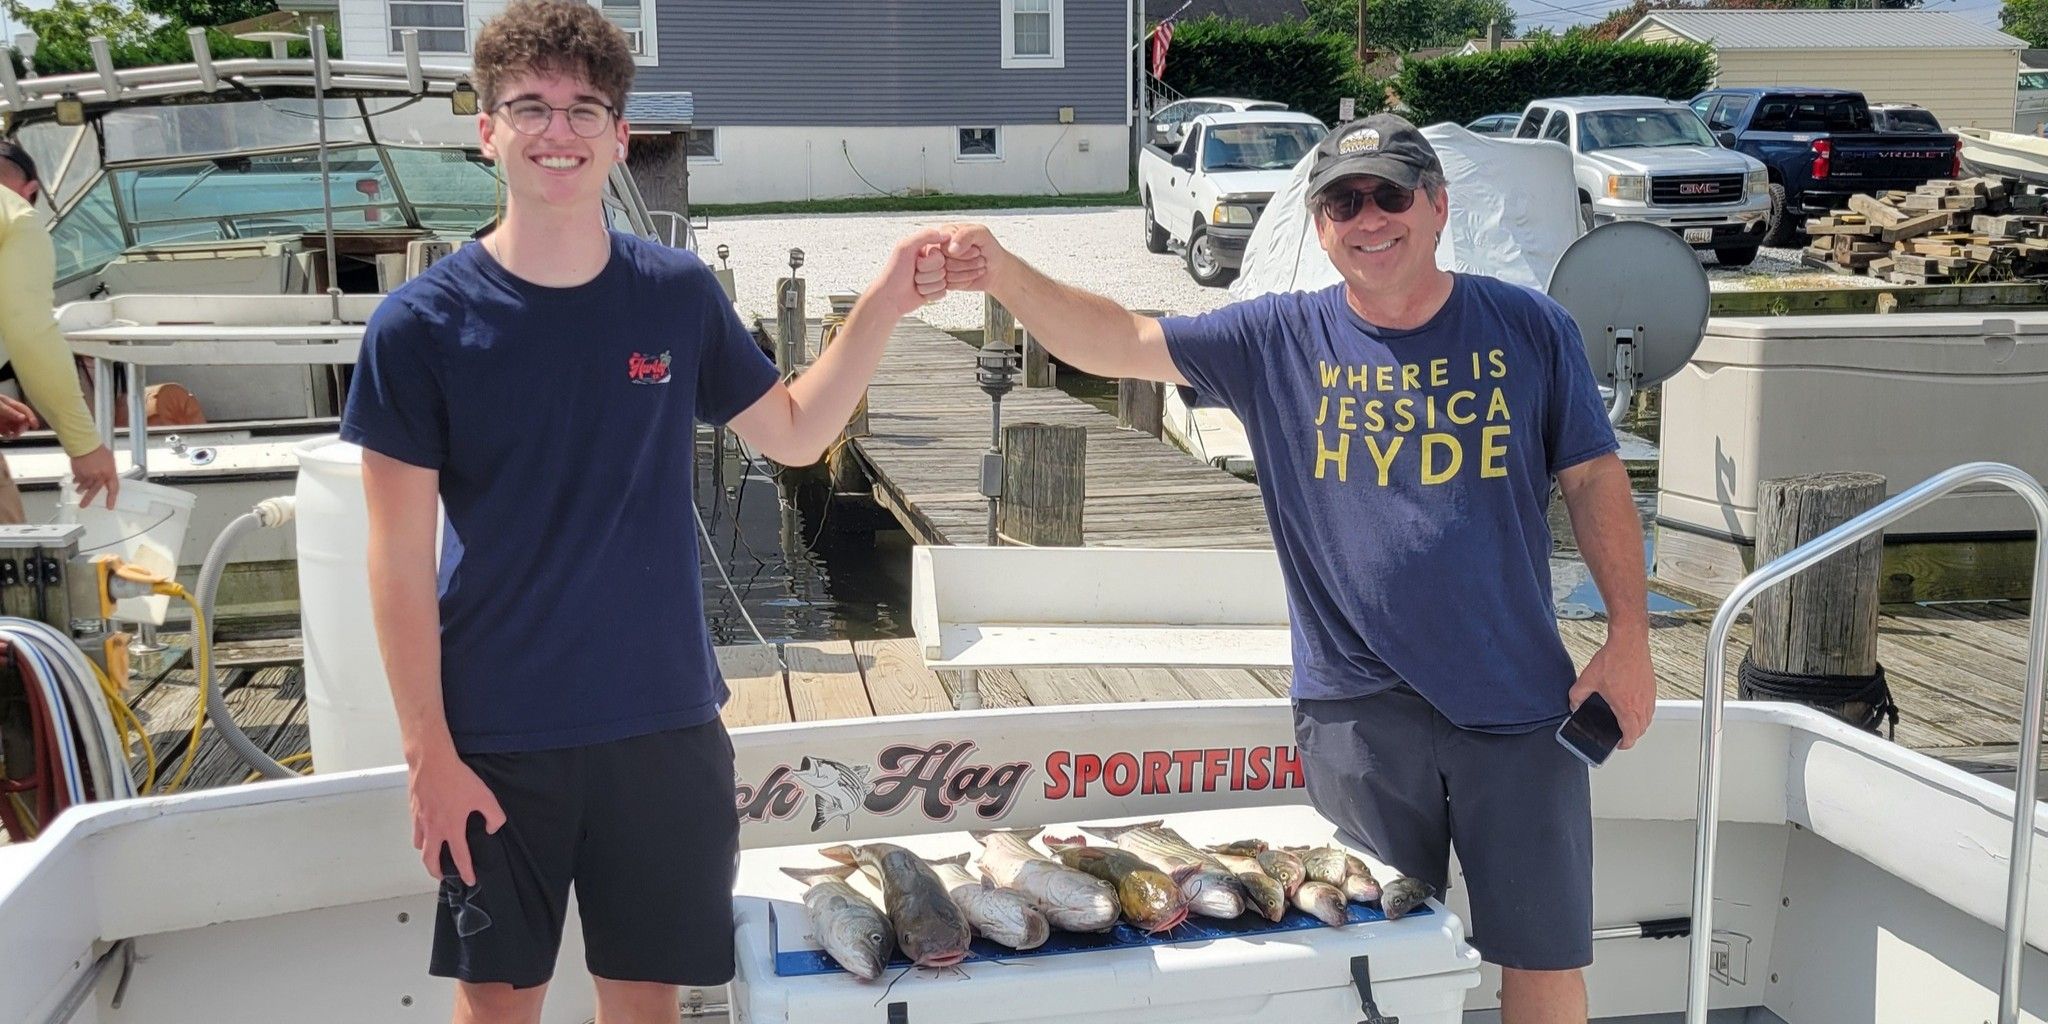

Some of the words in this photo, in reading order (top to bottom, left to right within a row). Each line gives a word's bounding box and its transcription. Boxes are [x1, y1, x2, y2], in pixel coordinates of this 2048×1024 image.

[1339, 144, 1379, 155] SALVAGE
[1680, 182, 1720, 194] GMC
[1319, 358, 1449, 392] WHERE
[1472, 349, 1507, 380] IS
[1314, 387, 1511, 432] JESSICA
[1314, 425, 1511, 486] HYDE
[862, 740, 1032, 821] Hag
[1043, 746, 1306, 800] SPORTFISH
